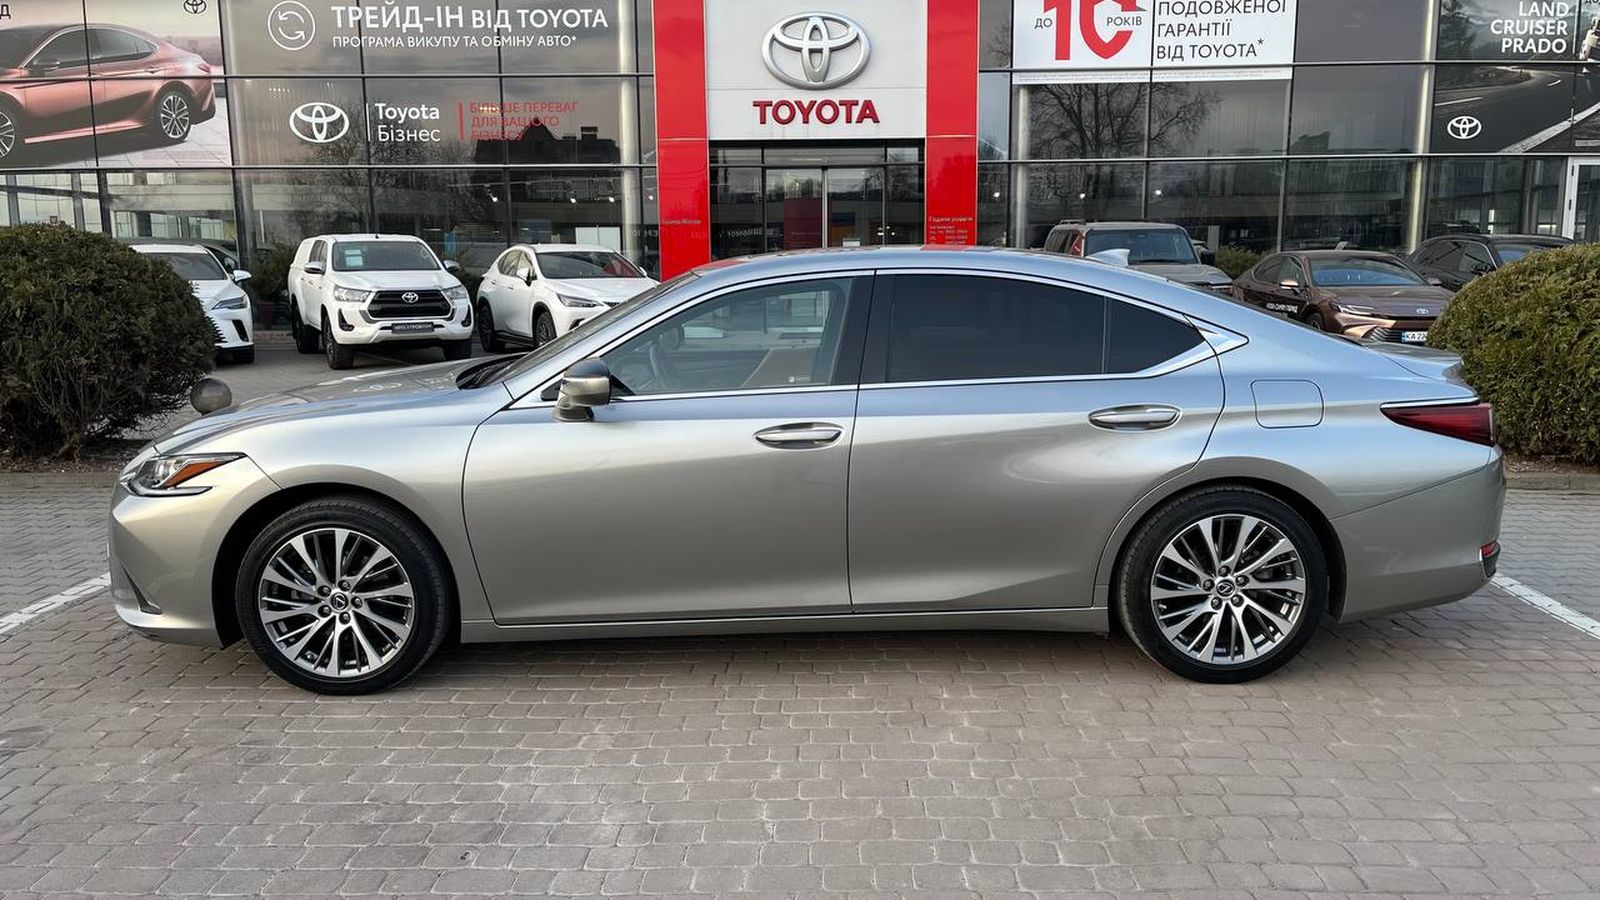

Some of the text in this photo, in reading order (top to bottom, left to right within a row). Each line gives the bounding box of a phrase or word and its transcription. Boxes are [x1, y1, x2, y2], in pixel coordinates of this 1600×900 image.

[331, 1, 463, 32] ТРЕЙД-ІН
[472, 9, 511, 33] ВІД
[1519, 1, 1570, 17] LAND
[1034, 18, 1053, 30] ДО
[1106, 16, 1143, 27] РОКІВ
[1157, 18, 1231, 37] ГАРАНТІЇ
[1490, 19, 1568, 35] CRUISER
[332, 36, 404, 48] ПРОГРАМА
[408, 36, 459, 48] ВИКУПУ
[462, 36, 479, 47] ТА
[480, 36, 534, 48] ОБМІНУ
[1501, 38, 1567, 53] PRADO
[1156, 45, 1185, 62] ВІД
[375, 103, 440, 123] Toyota
[523, 101, 578, 113] ПЕРЕВАГ
[752, 99, 880, 125] TOYOTA
[471, 116, 497, 127] ДЛЯ
[378, 125, 440, 142] Бізнес
